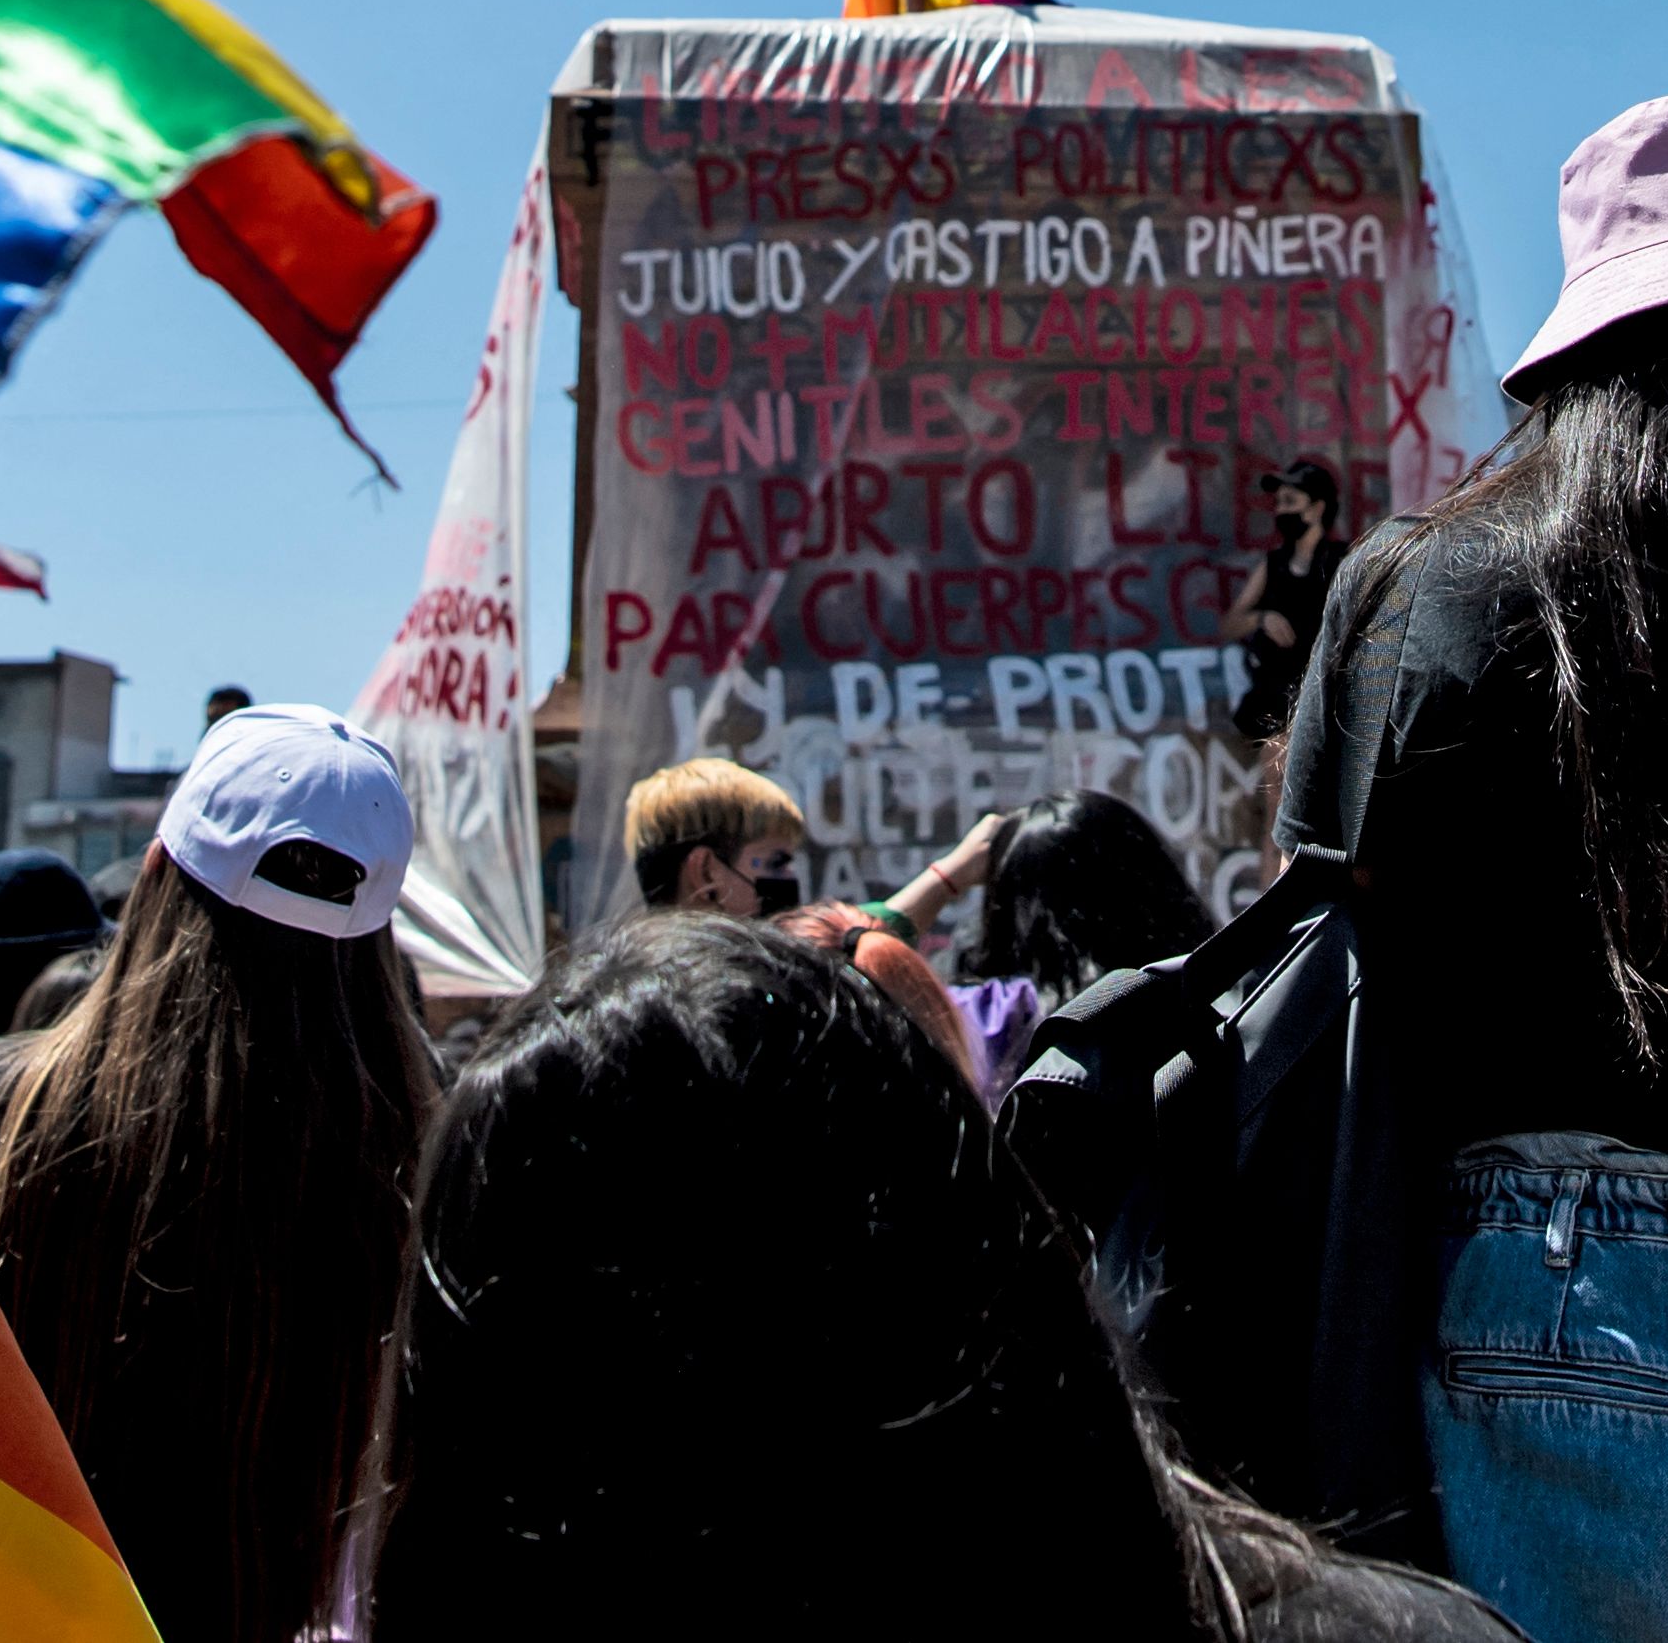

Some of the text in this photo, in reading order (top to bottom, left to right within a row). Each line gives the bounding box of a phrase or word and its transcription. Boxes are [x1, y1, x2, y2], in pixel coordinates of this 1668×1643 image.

[1087, 48, 1154, 116] A
[1179, 46, 1366, 115] LES
[1012, 116, 1368, 204] POLITICXS
[617, 205, 1385, 319] JUICIO Y CASTIGO A PIÑERA
[621, 314, 732, 395] NO
[747, 313, 813, 392] +
[821, 278, 1383, 384] MUTILACIONES
[1054, 361, 1432, 448] INTERSEX
[800, 565, 1160, 659] CUERPES
